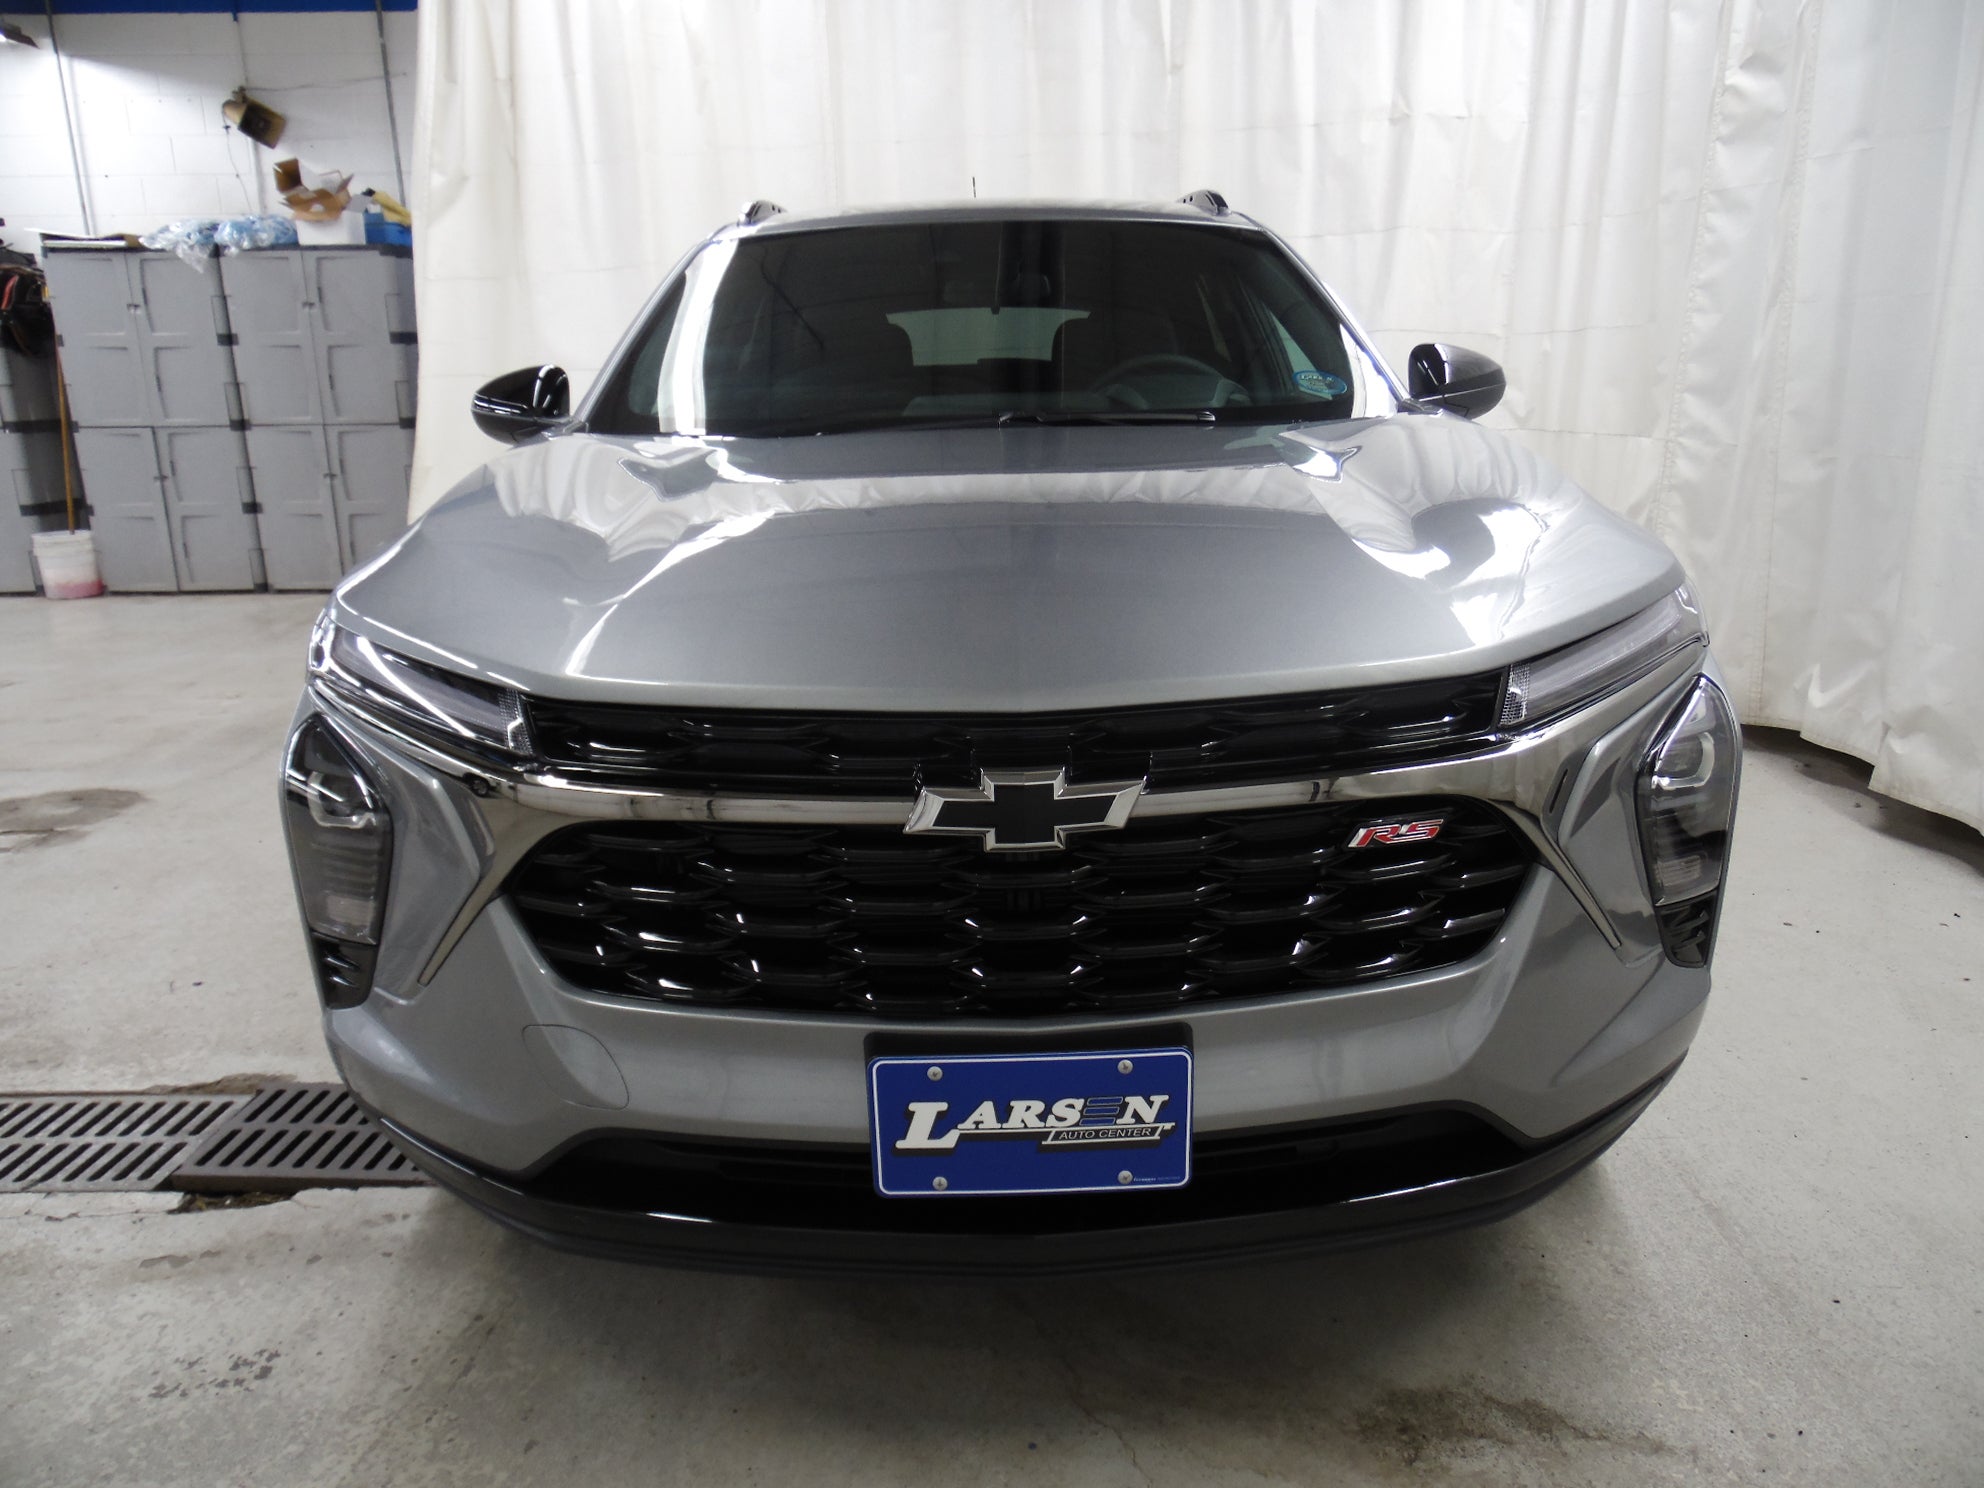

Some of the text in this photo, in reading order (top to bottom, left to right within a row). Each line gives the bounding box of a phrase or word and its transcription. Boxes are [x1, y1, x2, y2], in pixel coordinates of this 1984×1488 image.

[1348, 819, 1443, 847] RS
[895, 1095, 1170, 1149] LARSEN
[1059, 1127, 1152, 1140] AUTO CENTER
